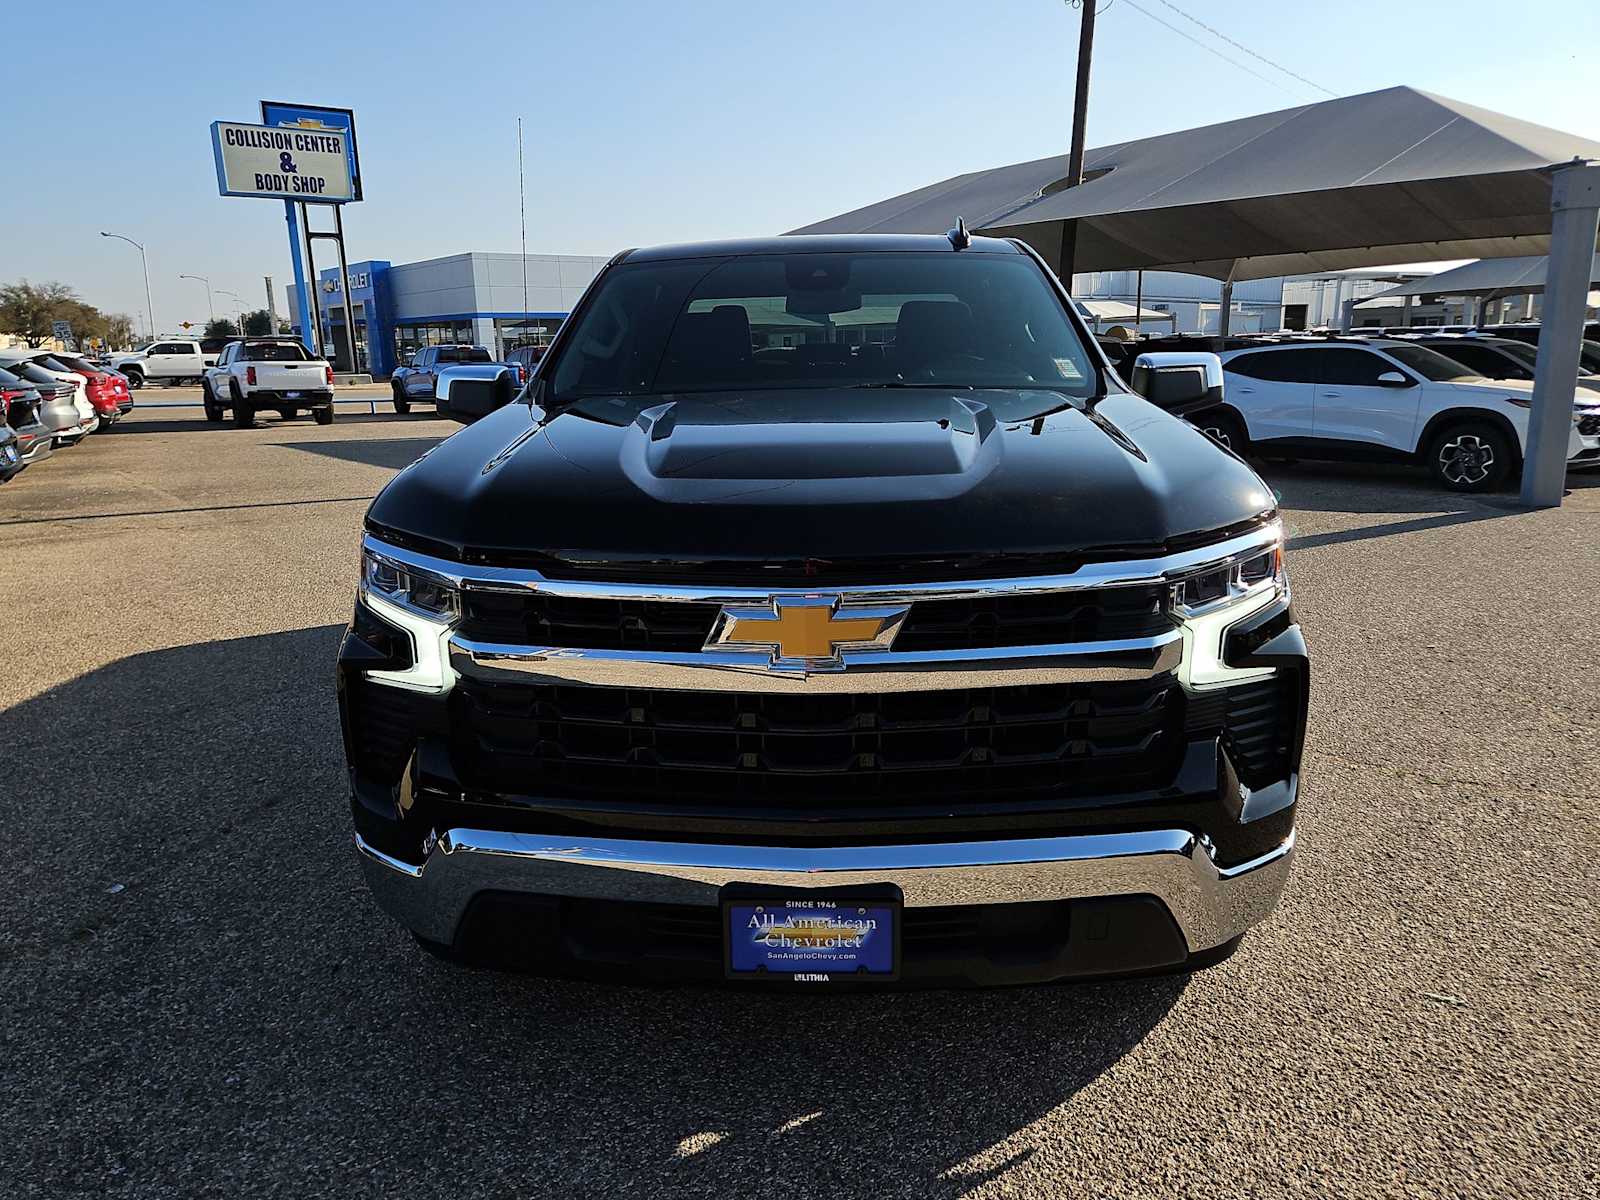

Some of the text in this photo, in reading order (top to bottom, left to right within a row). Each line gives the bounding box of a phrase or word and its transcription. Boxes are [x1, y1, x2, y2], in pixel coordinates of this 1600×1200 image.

[225, 128, 341, 154] COLLISION CENTER
[279, 151, 298, 173] &
[254, 173, 325, 194] BODY SHOP
[333, 271, 368, 292] CROLET
[785, 900, 837, 909] SINCE 1946
[748, 913, 877, 930] All American
[765, 933, 864, 949] Chevrolet
[767, 951, 857, 961] SanAngeloChevy.com
